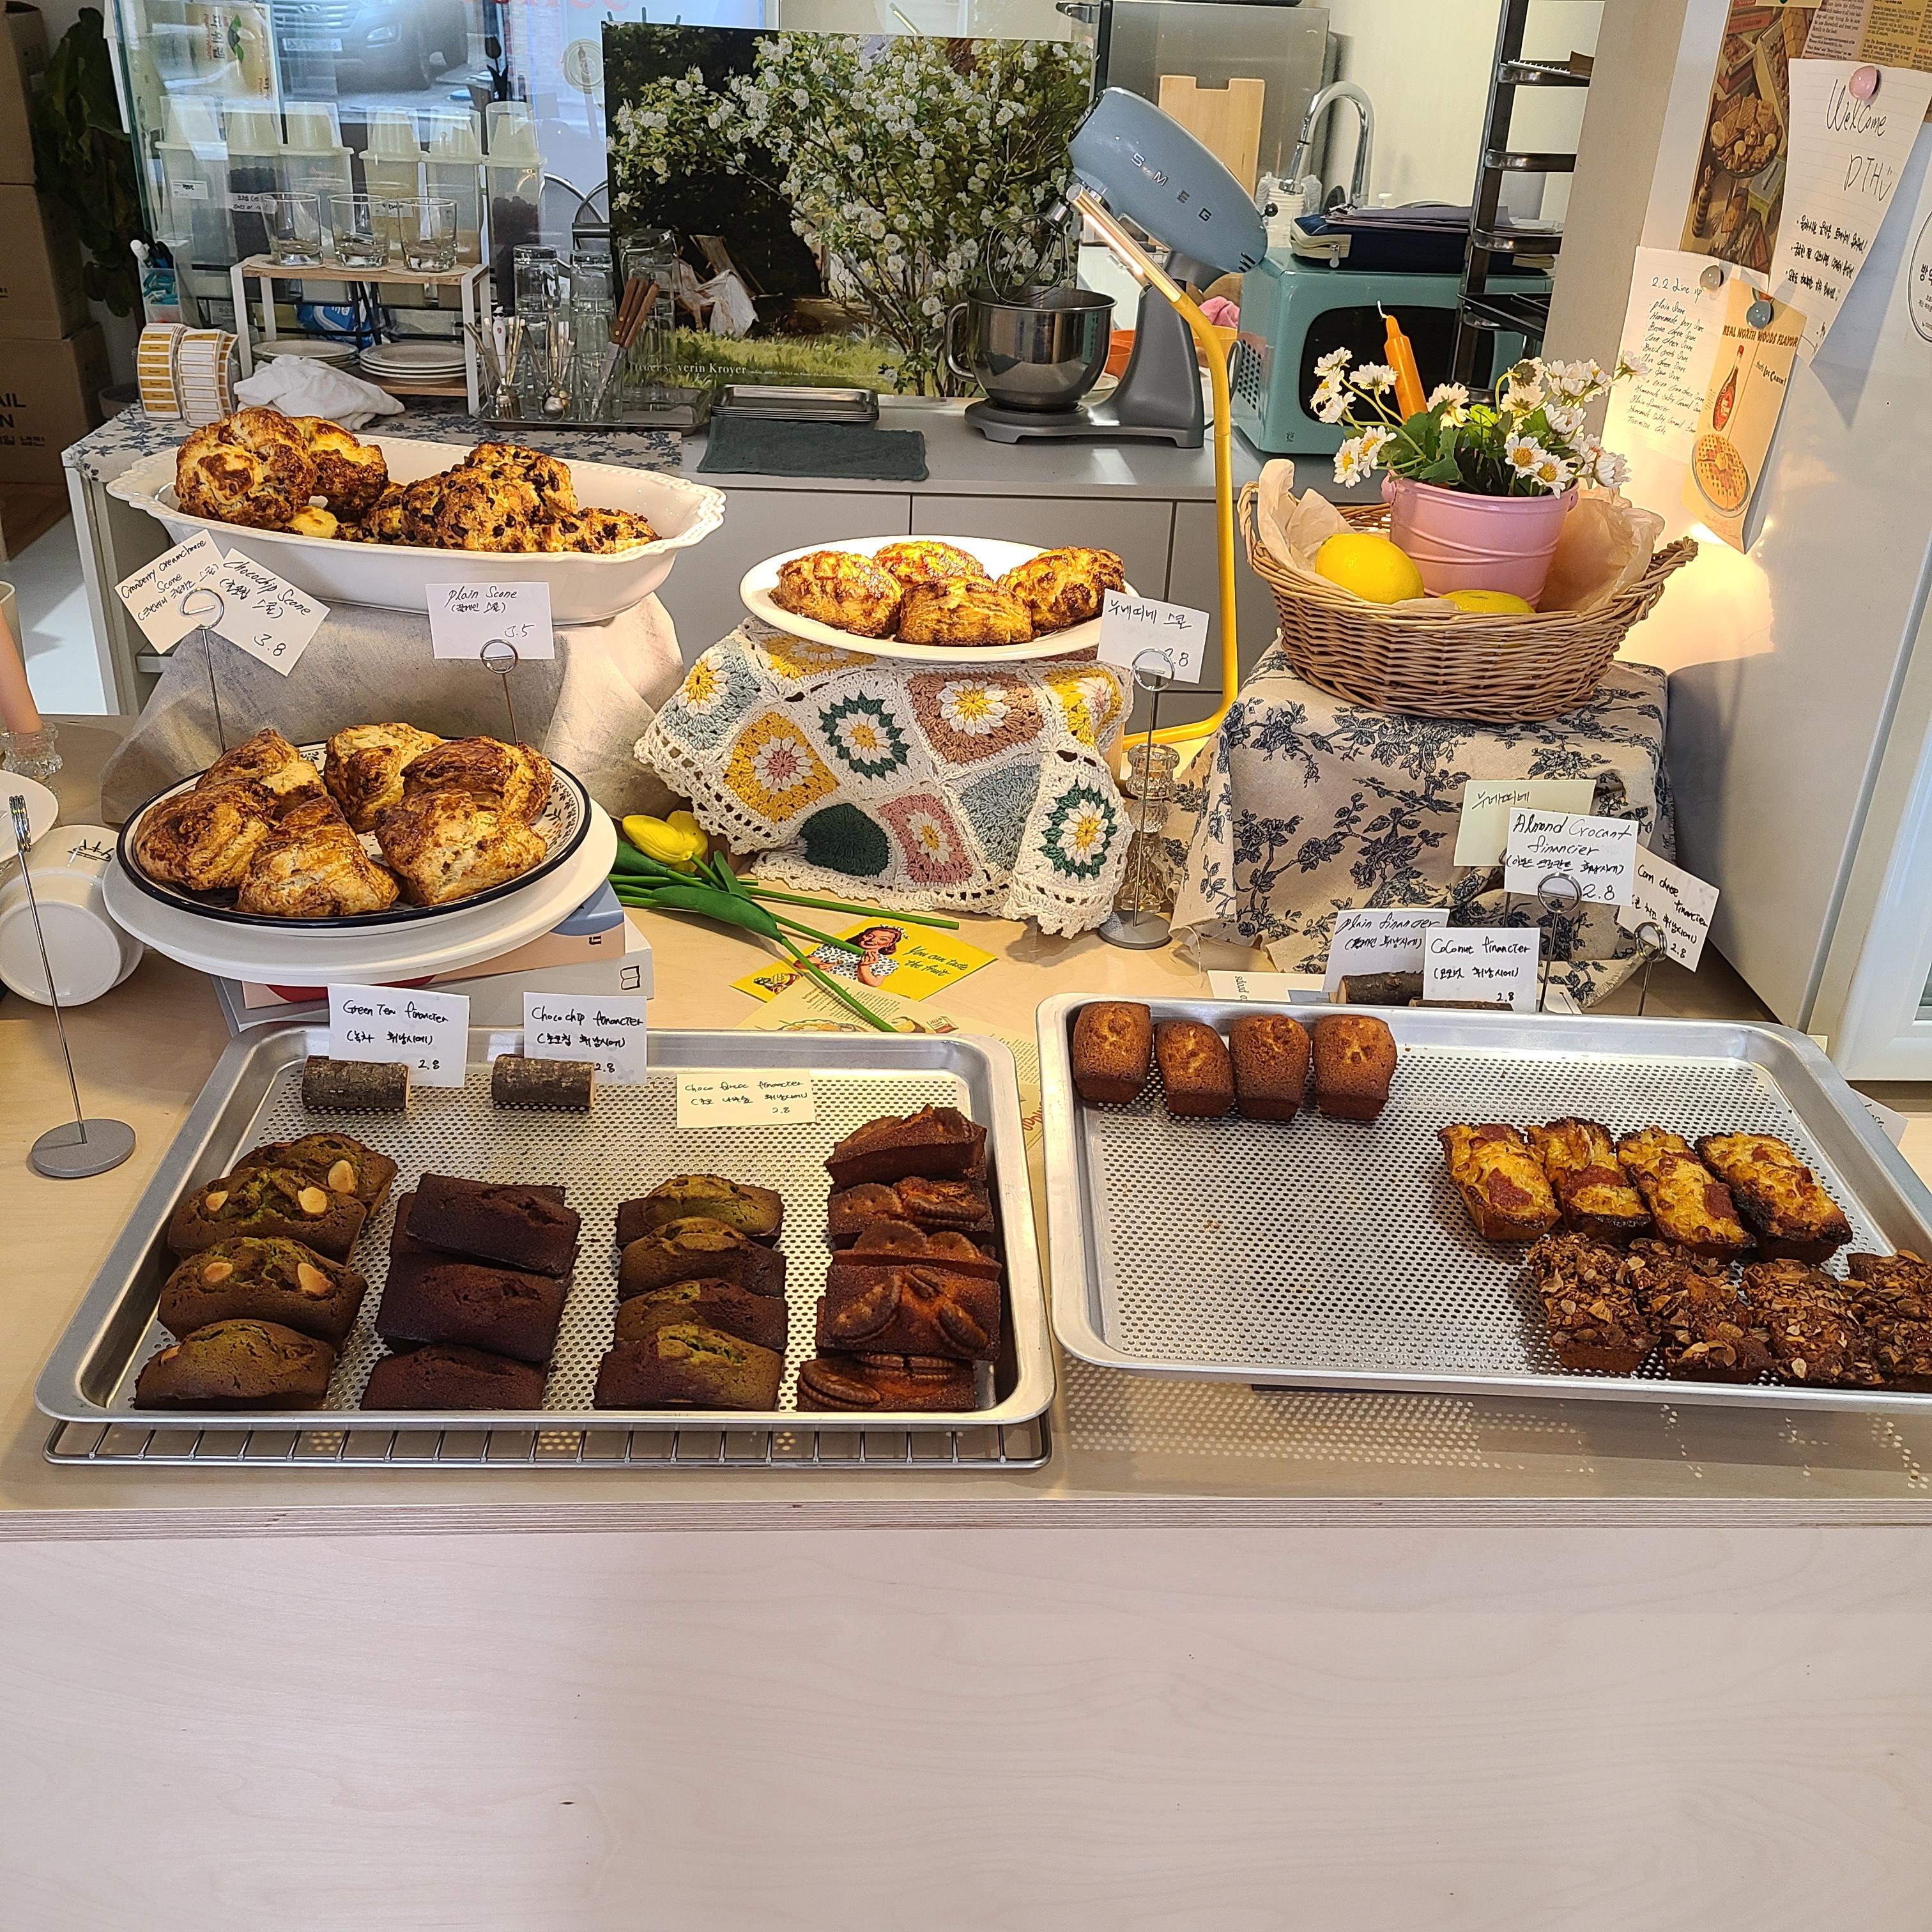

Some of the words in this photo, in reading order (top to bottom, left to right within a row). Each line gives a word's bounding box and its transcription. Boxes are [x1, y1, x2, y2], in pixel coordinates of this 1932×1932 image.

[1131, 153, 1213, 222] SMEG
[1722, 325, 1736, 337] REAL
[1737, 327, 1756, 341] NORTH
[1757, 330, 1777, 344] WOODS
[1777, 334, 1798, 348] FLAVOR
[1163, 613, 1192, 629] 스콘
[505, 624, 535, 638] 3.5
[254, 633, 287, 657] 3.8
[1513, 813, 1569, 833] Almond
[1569, 819, 1633, 841] Crocant
[1582, 884, 1616, 901] 2.8
[902, 946, 929, 957] You
[1670, 944, 1687, 958] 2.8
[905, 960, 923, 969] the
[921, 965, 951, 976] fruit
[1496, 992, 1515, 1002] 2.8
[418, 1059, 440, 1070] 2.8
[594, 1062, 615, 1073] 2.8
